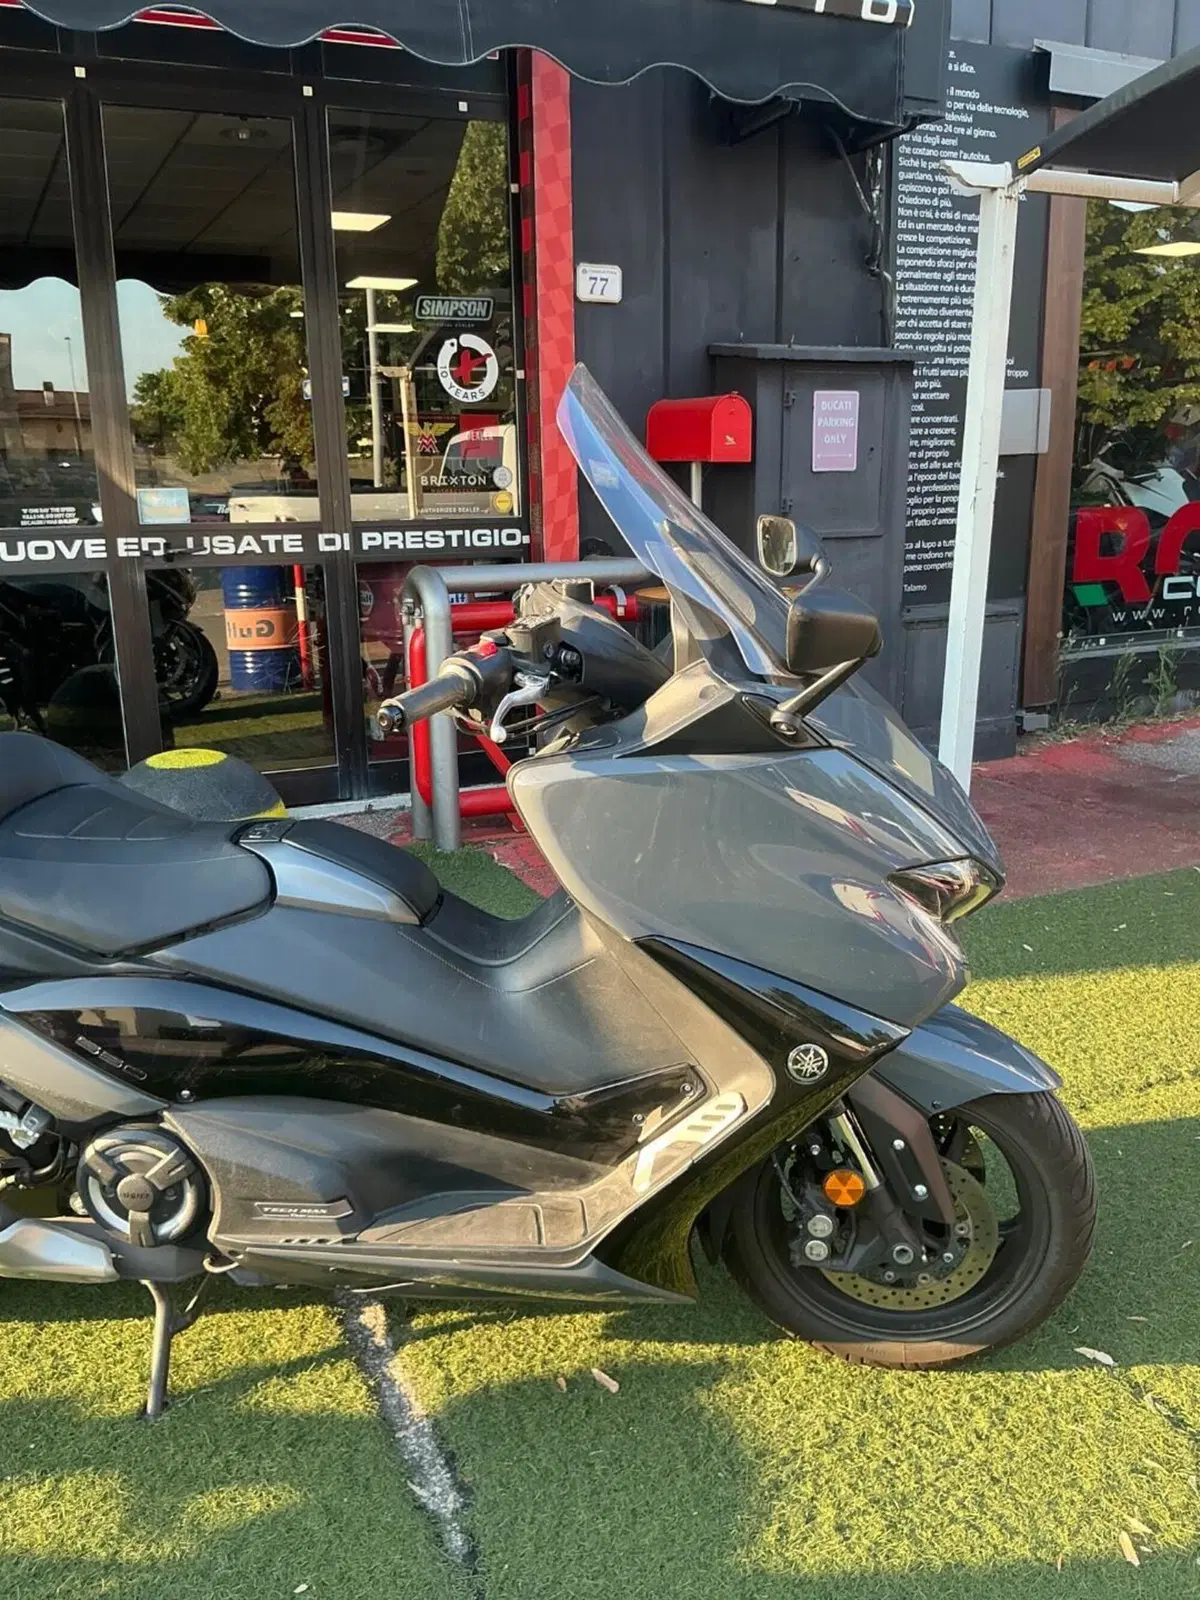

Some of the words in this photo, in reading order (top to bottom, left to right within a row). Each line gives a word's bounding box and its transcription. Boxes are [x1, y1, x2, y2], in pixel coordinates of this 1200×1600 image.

[960, 62, 976, 73] dice.
[955, 88, 980, 99] mondo
[953, 102, 965, 111] per
[966, 102, 976, 111] via
[977, 102, 993, 113] delle
[943, 124, 952, 133] 24
[953, 126, 965, 135] ore
[966, 127, 973, 135] al
[973, 128, 997, 139] giorno.
[912, 134, 922, 143] via
[923, 135, 940, 146] degli
[941, 137, 958, 146] aerei
[898, 145, 911, 154] che
[912, 147, 939, 157] costano
[940, 150, 959, 159] come
[898, 183, 931, 194] capiscono
[938, 186, 950, 196] poi
[898, 194, 931, 206] Chiedono
[932, 197, 939, 206] di
[898, 207, 913, 217] Non
[940, 210, 953, 219] crisi
[954, 211, 961, 220] di
[961, 212, 980, 220] matu
[897, 219, 907, 229] Ed
[908, 220, 915, 229] in
[915, 222, 925, 230] un
[926, 223, 954, 232] mercato
[955, 223, 967, 233] che
[897, 233, 918, 241] cresce
[918, 233, 925, 242] la
[897, 244, 905, 254] La
[906, 245, 951, 256] competizione
[952, 247, 978, 259] miglior
[896, 256, 936, 268] imponendo
[937, 258, 955, 268] sforzi
[956, 261, 967, 271] per
[896, 269, 941, 281] giornalmente
[942, 271, 955, 282] agli
[956, 272, 976, 281] stand
[589, 276, 609, 295] 77
[896, 281, 904, 291] La
[905, 281, 940, 291] situazione
[901, 295, 949, 304] estremamente
[950, 295, 961, 306] più
[421, 299, 488, 317] SIMPSON
[896, 307, 917, 316] Anche
[918, 307, 938, 316] molto
[908, 319, 918, 328] chi
[919, 320, 942, 328] accetta
[943, 319, 950, 328] di
[951, 320, 967, 328] stare
[895, 331, 922, 340] secondo
[924, 332, 945, 342] regole
[946, 332, 957, 342] più
[930, 343, 946, 352] volta
[947, 343, 953, 352] si
[945, 356, 970, 366] impres
[922, 367, 940, 376] frutti
[940, 369, 958, 377] senza
[1007, 369, 1029, 378] troppo
[440, 365, 449, 379] 10
[447, 382, 486, 400] YEARS
[915, 380, 928, 389] può
[920, 392, 950, 400] accettare
[820, 400, 852, 412] DUCATI
[817, 416, 855, 428] PARKING
[921, 415, 959, 423] concentrati.
[823, 433, 848, 444] ONLY
[917, 449, 924, 458] al
[924, 449, 950, 460] proprio
[919, 461, 929, 469] ed
[929, 461, 941, 469] alle
[420, 475, 487, 487] BRIXTON
[913, 473, 937, 482] l'epoca
[937, 472, 948, 480] del
[922, 483, 960, 494] professionis
[923, 496, 935, 505] per
[935, 495, 941, 503] la
[942, 495, 960, 504] prop
[911, 507, 935, 517] proprio
[915, 517, 931, 527] fatto
[932, 517, 958, 525] d'amor
[0, 538, 108, 562] UOVE
[185, 533, 304, 556] USATE
[318, 532, 350, 552] DI
[914, 540, 921, 549] al
[922, 541, 936, 550] lupo
[917, 551, 944, 560] credono
[904, 564, 922, 574] paese
[904, 584, 927, 592] Talamo
